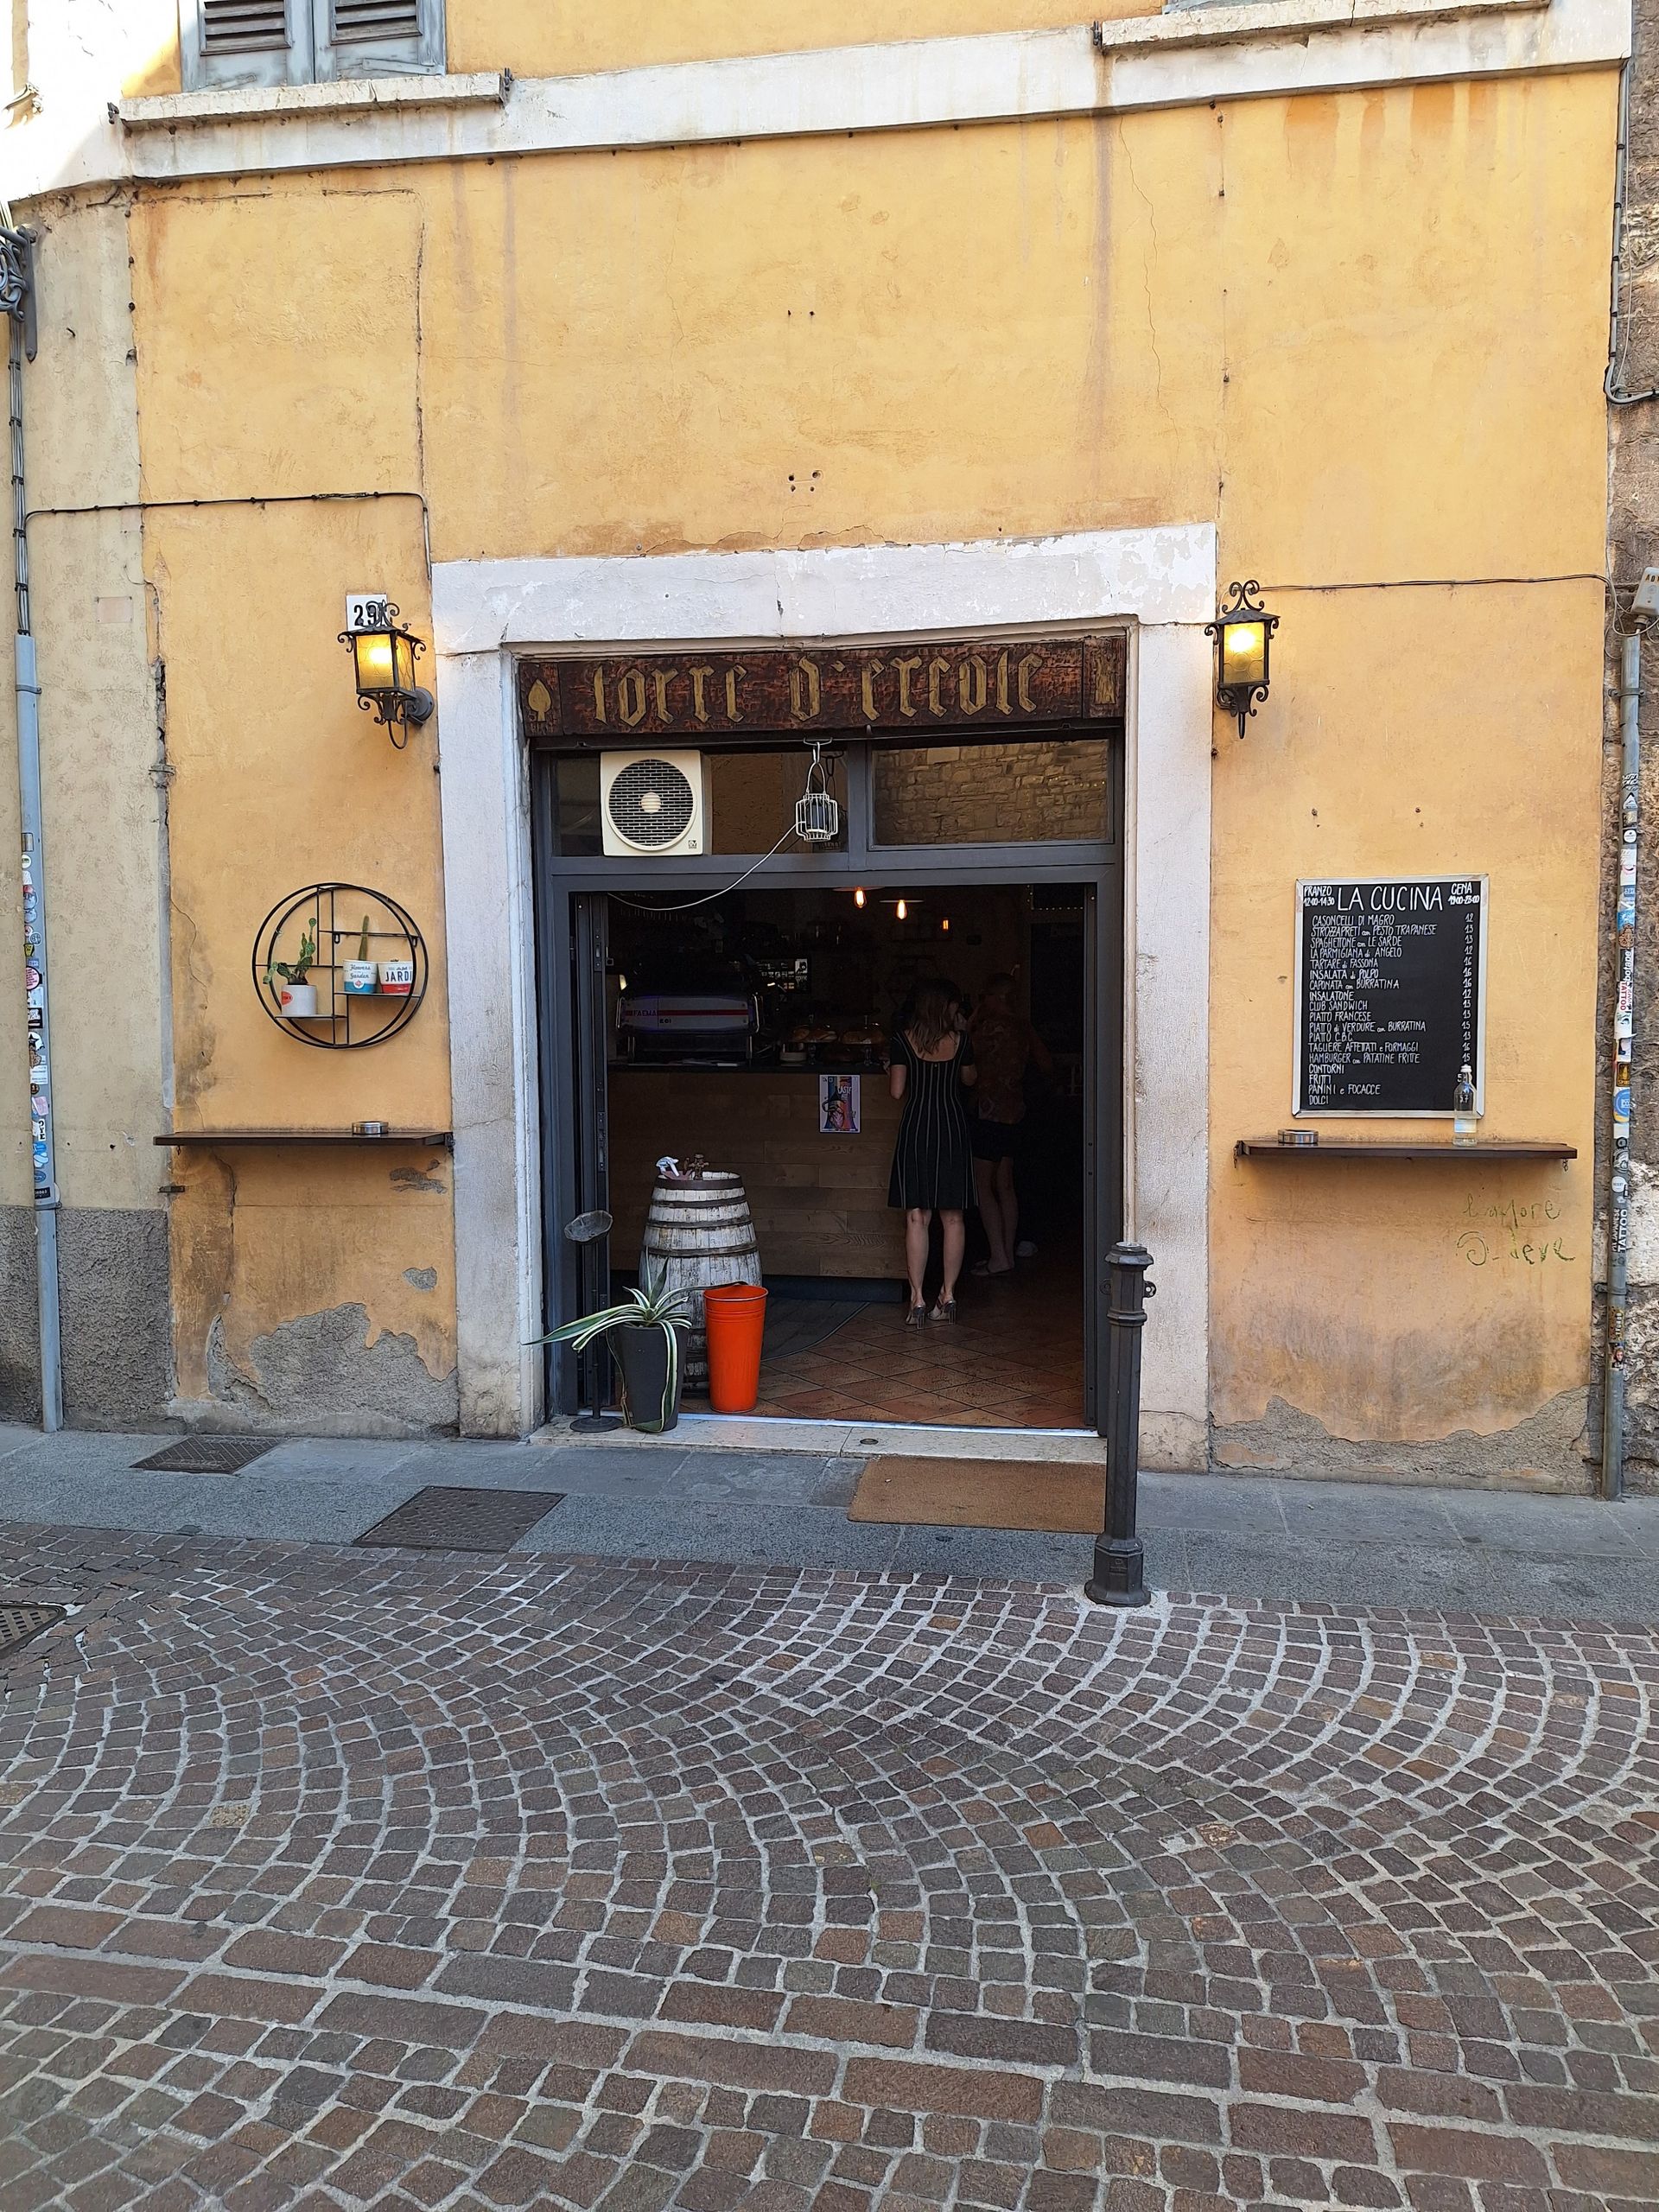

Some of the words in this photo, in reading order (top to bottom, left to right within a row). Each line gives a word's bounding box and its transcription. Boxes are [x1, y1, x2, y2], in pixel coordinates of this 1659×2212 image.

[1304, 886, 1332, 897] PRANZO
[1451, 882, 1472, 895] CENA
[1338, 887, 1364, 911] LA
[1370, 886, 1443, 911] CUCINA
[1312, 915, 1354, 926] CASONCELLI
[1358, 915, 1364, 925] DI
[1367, 914, 1395, 925] MAGRO
[1465, 913, 1474, 923] 12
[1311, 925, 1361, 937] STROZZAPRETI
[1372, 925, 1394, 936] PESTO
[1395, 925, 1438, 935] TRAPANESE
[1465, 925, 1474, 933] 13
[1310, 938, 1357, 948] SPAGHETTONE
[1368, 937, 1376, 947] LE
[1378, 936, 1402, 947] SARDE
[1465, 935, 1473, 944] 13
[1310, 948, 1319, 958] LA
[1319, 947, 1363, 958] PARMIGIANA
[1375, 947, 1402, 957] ANGELO
[1465, 945, 1473, 955] 12
[1310, 958, 1342, 969] TARTARE
[1350, 958, 1378, 968] FASSONA
[1310, 969, 1348, 980] INSALATA
[1358, 969, 1379, 979] POLPO
[1463, 967, 1472, 977] 16
[1309, 980, 1343, 990] CAPONATA
[1356, 979, 1400, 989] BURRATINA
[1463, 977, 1472, 988] 16
[1309, 990, 1355, 1001] INSALATONE
[1462, 988, 1472, 999] 12
[1309, 1001, 1325, 1011] CLUB
[1329, 1001, 1368, 1011] SANDWICH
[1462, 999, 1471, 1008] 13
[1309, 1011, 1332, 1021] PIATTO
[1335, 1011, 1371, 1021] FRANCESE
[1309, 1022, 1332, 1033] PIATTO
[1342, 1022, 1376, 1032] VERDURE
[1388, 1020, 1427, 1032] BURRATINA
[1461, 1020, 1471, 1030] 15
[1309, 1033, 1332, 1042] PIATTO
[1308, 1042, 1342, 1052] TAGLIERE
[1344, 1042, 1377, 1052] AFFETTATI
[1384, 1042, 1419, 1052] FORMAGGI
[1309, 1053, 1351, 1064] HAMBURGER
[1363, 1053, 1395, 1064] PATATINE
[1398, 1053, 1421, 1064] FRITTE
[1462, 1052, 1471, 1062] 15
[1308, 1064, 1344, 1074] CONTORNI
[1309, 1074, 1331, 1084] FRITTI
[1308, 1084, 1336, 1095] PANINI
[1348, 1084, 1381, 1095] FOCACCE
[1309, 1095, 1329, 1105] DOLCI
